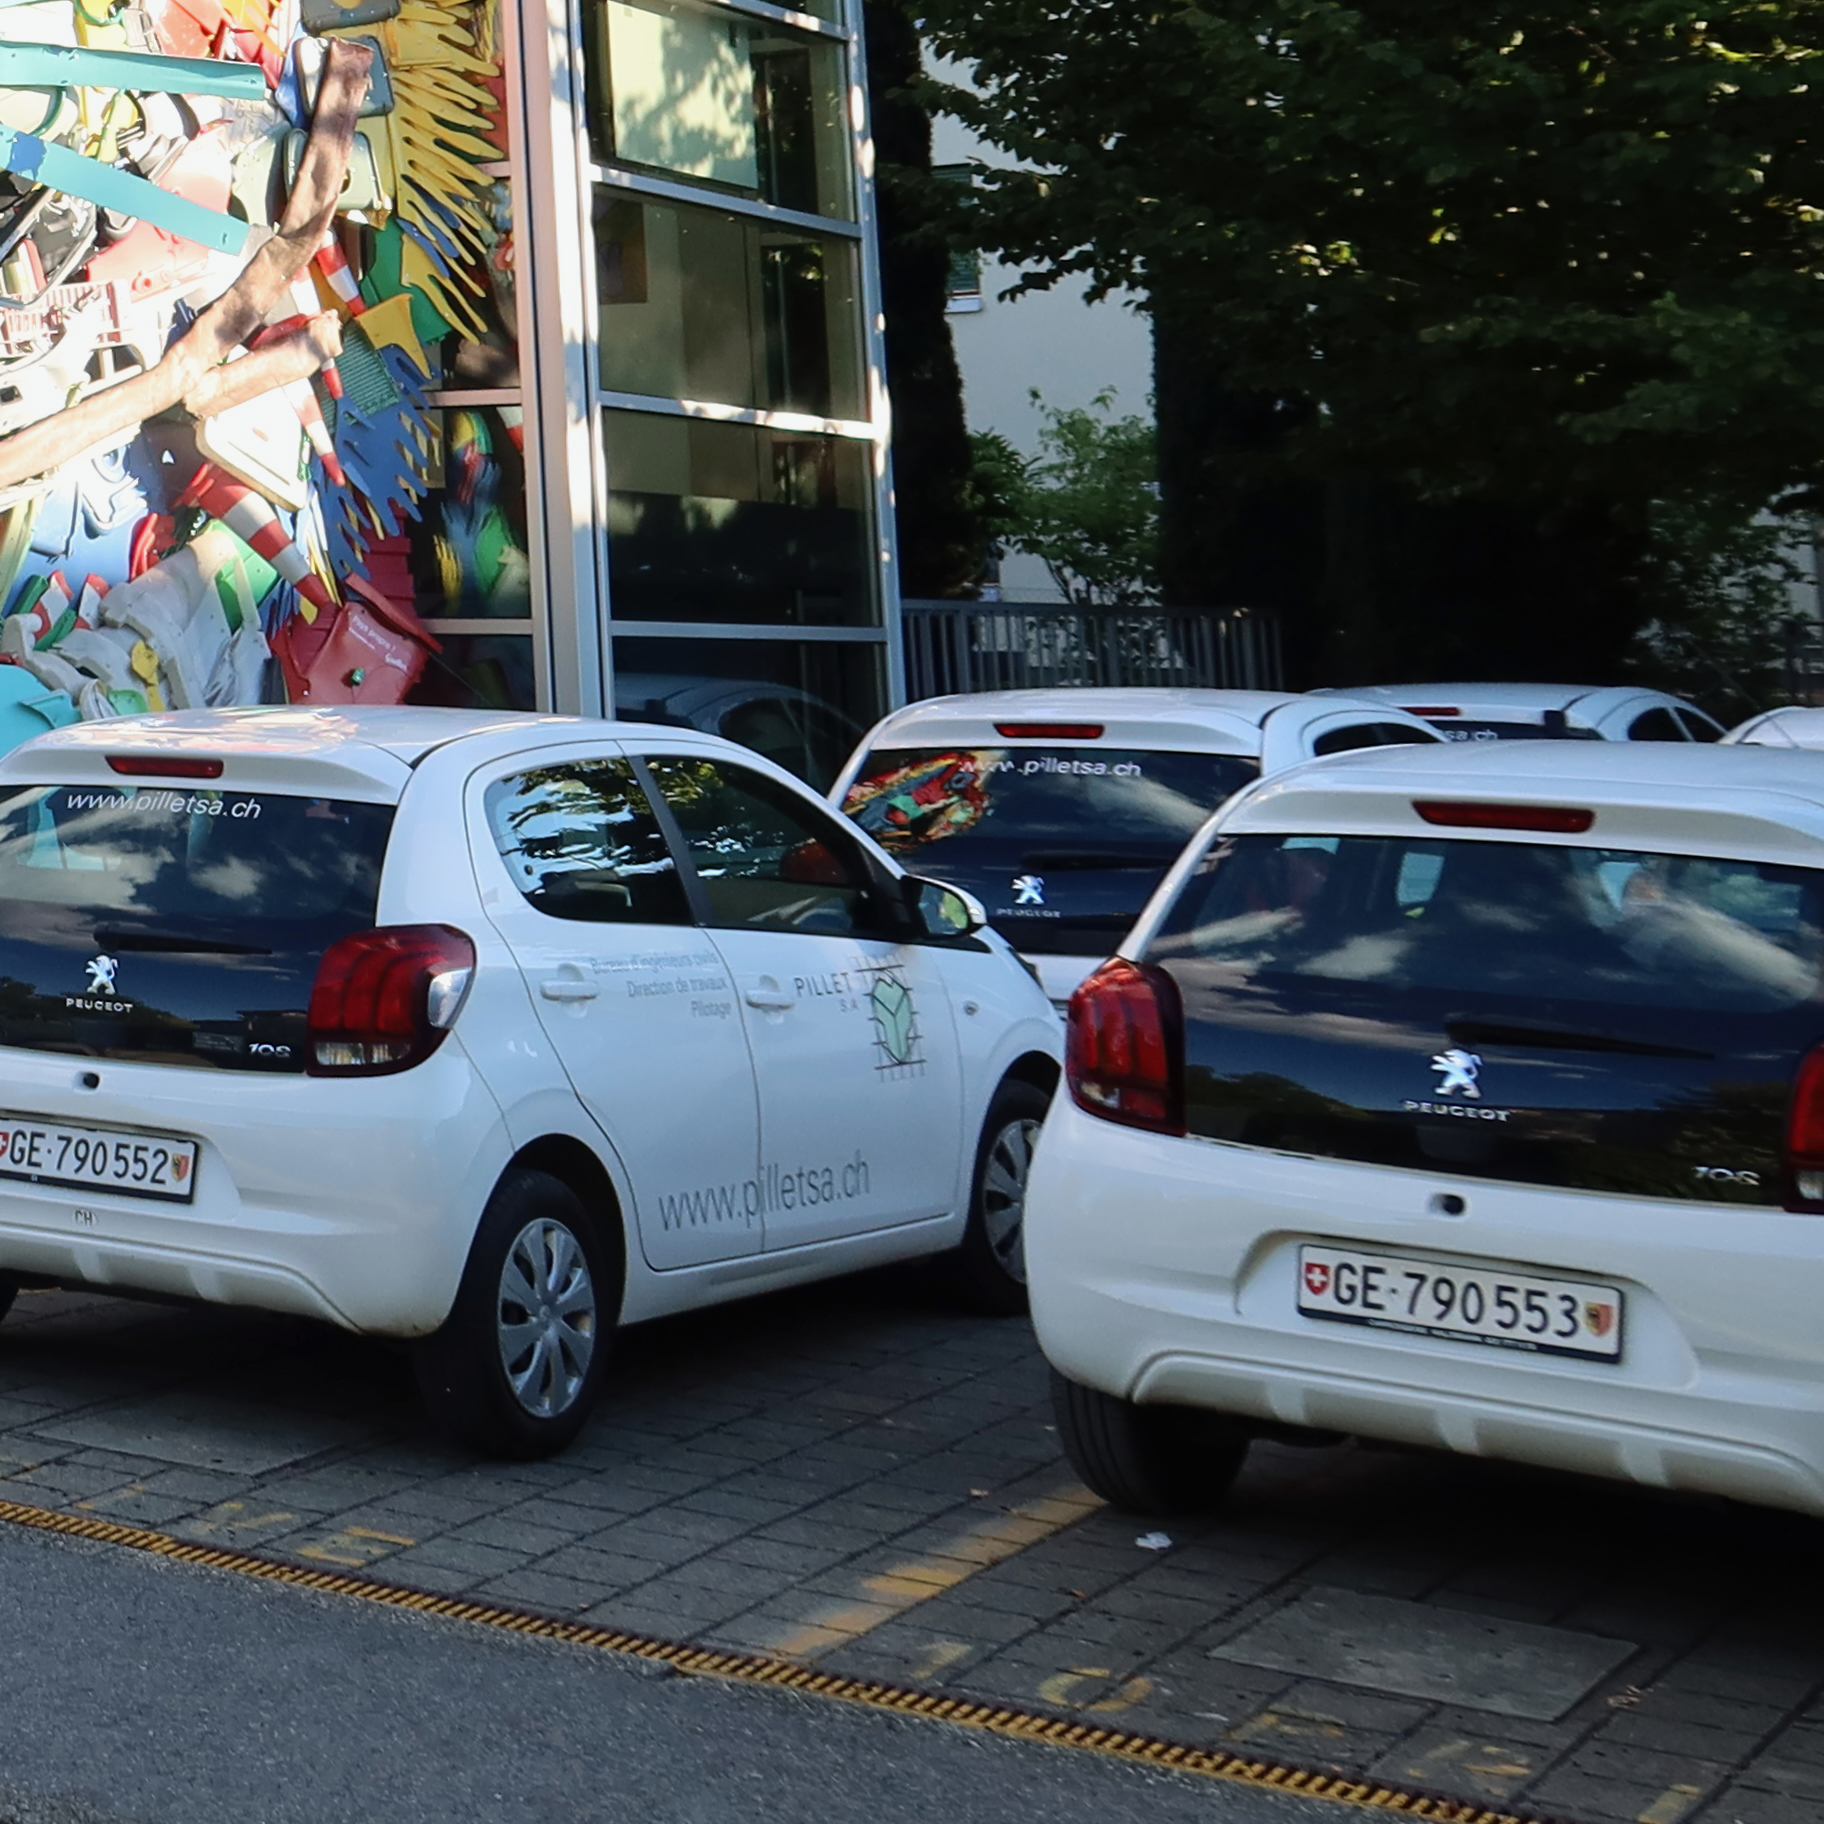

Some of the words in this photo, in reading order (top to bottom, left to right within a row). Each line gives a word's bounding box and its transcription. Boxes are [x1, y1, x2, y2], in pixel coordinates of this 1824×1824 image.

[67, 790, 262, 820] www.pilletsa.ch
[794, 972, 852, 998] PILLET
[65, 997, 134, 1014] PEUGEOT
[1403, 1100, 1511, 1123] PEUGEOT
[657, 1148, 870, 1232] www.pilletsa.ch
